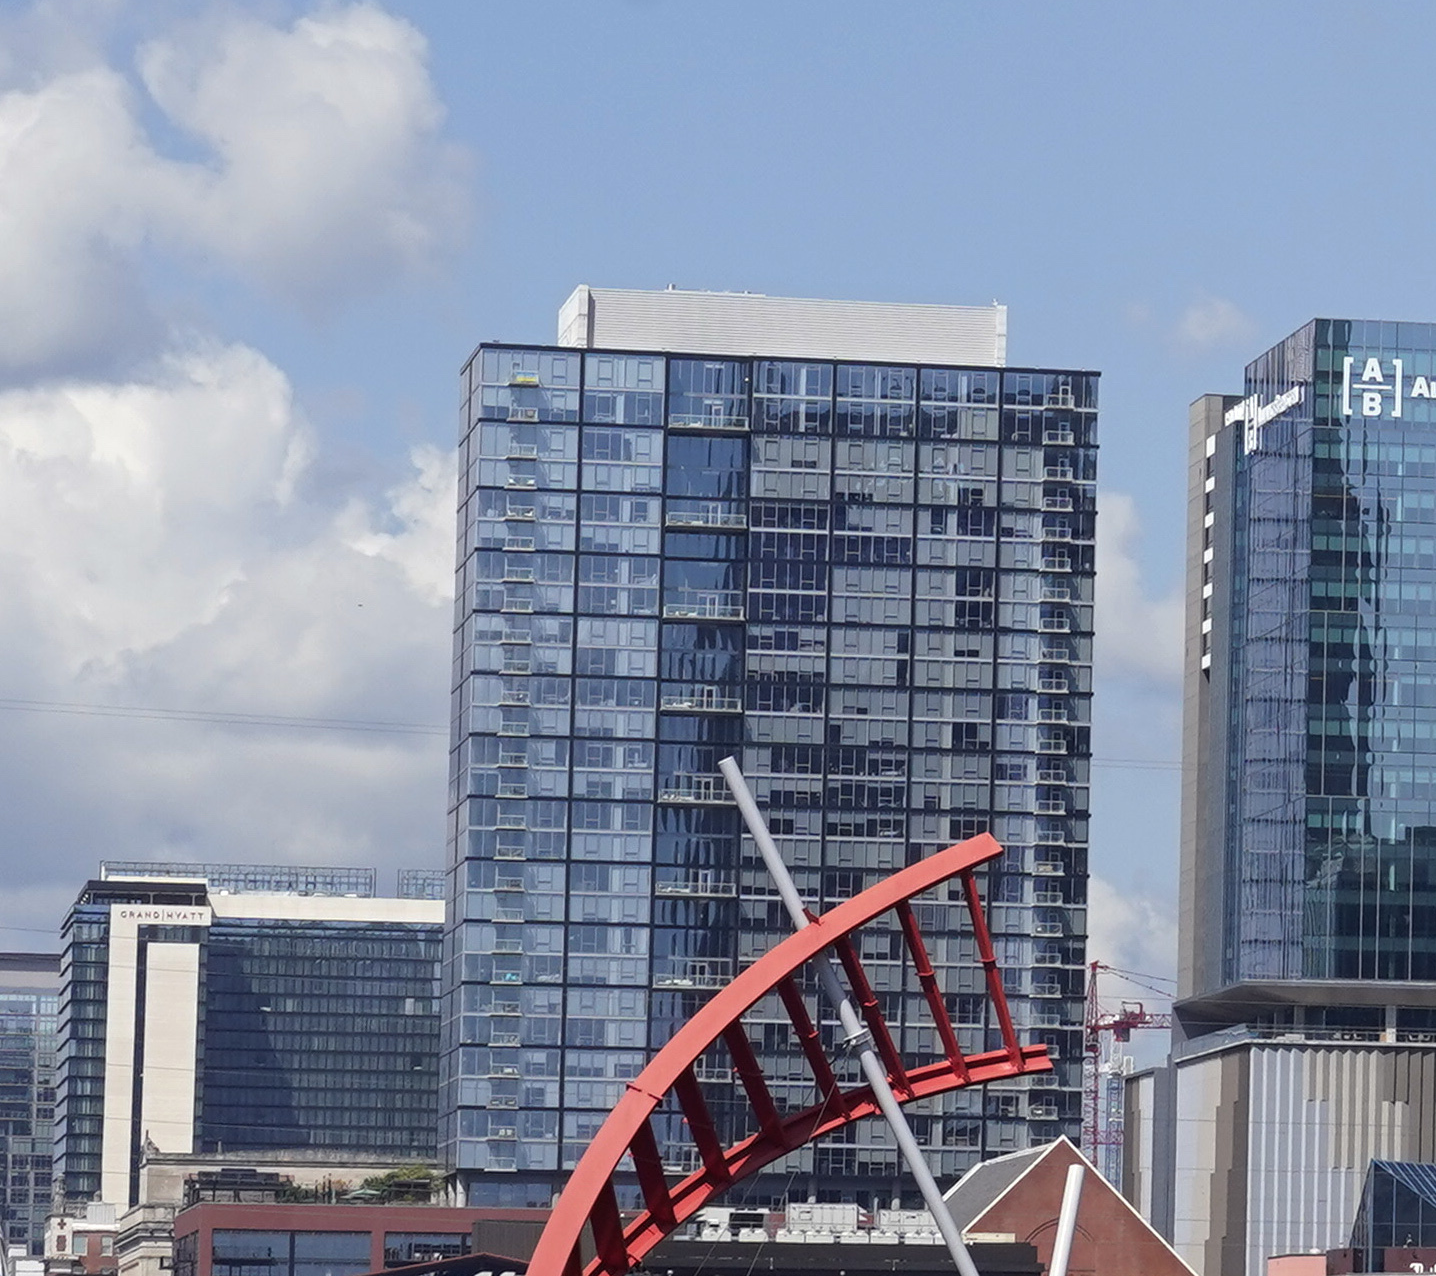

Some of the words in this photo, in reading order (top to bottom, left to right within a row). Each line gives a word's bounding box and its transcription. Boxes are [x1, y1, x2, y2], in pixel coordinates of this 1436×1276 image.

[1361, 357, 1384, 382] A
[1362, 392, 1382, 416] B
[121, 910, 159, 919] GRAND
[166, 911, 204, 920] HYATT
